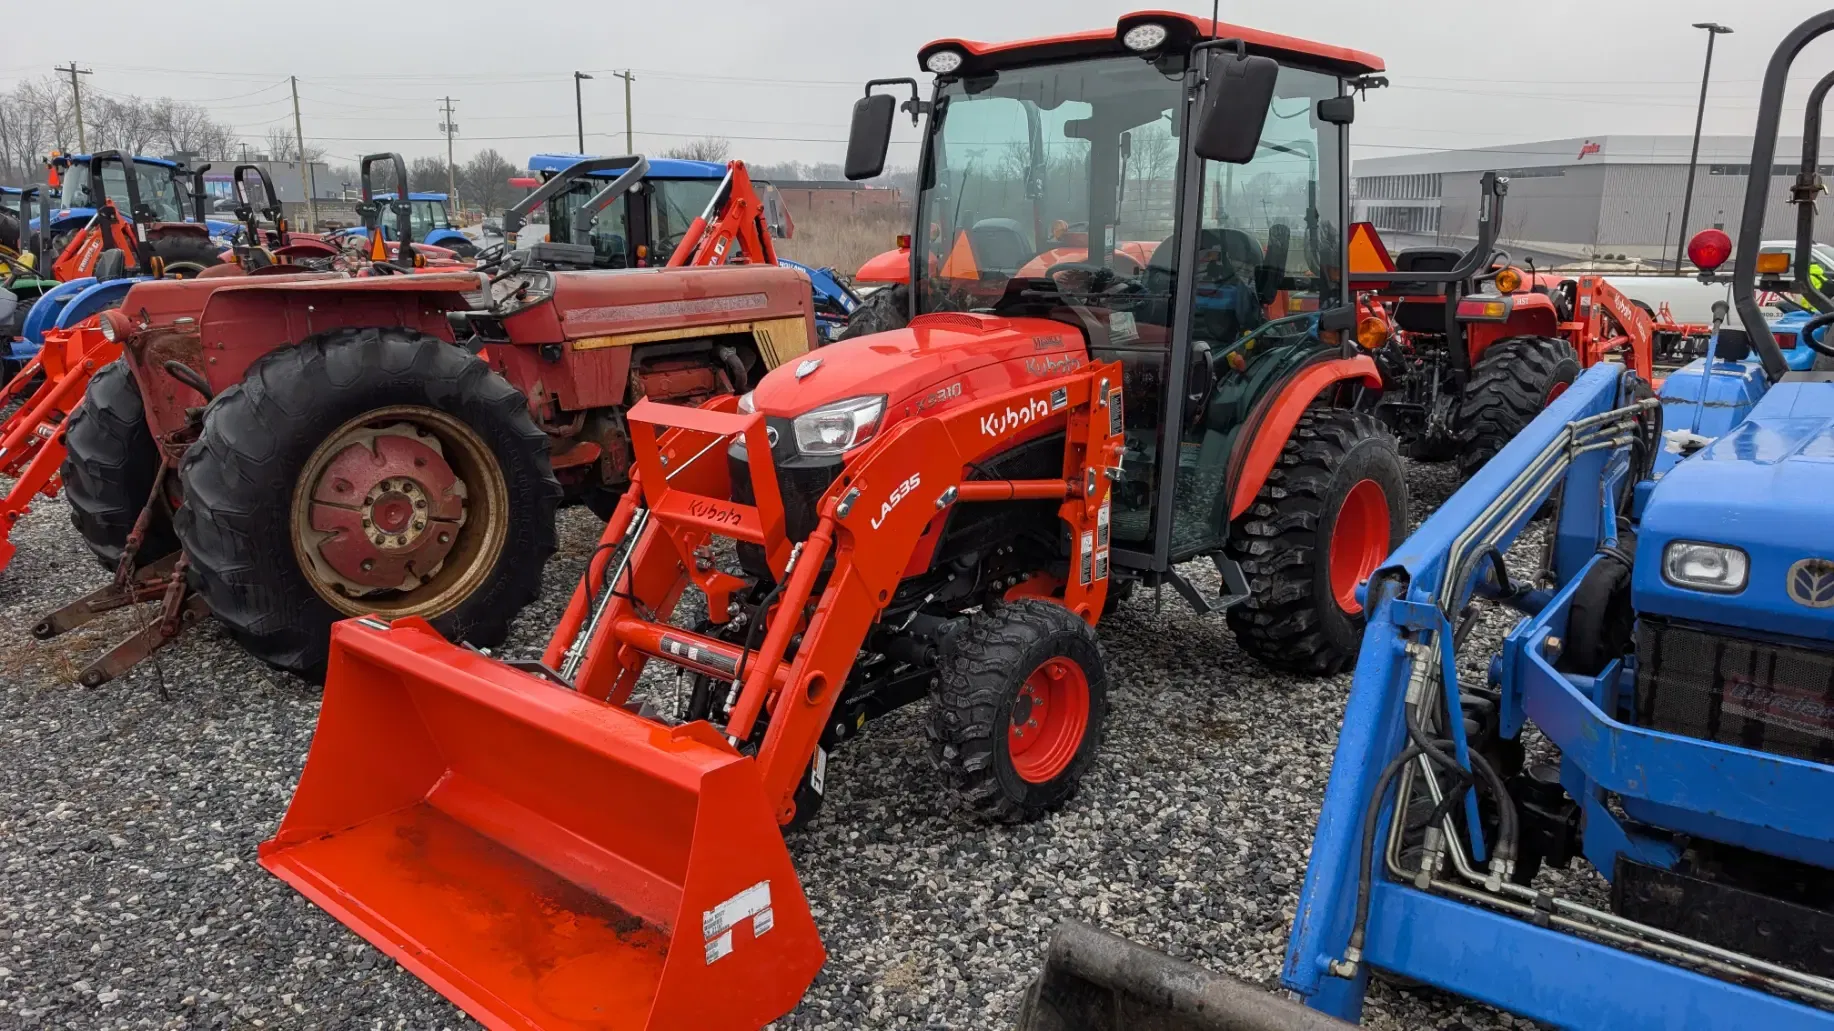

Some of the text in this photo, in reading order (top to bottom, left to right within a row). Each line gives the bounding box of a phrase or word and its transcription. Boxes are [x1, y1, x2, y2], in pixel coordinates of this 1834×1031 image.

[1025, 353, 1081, 377] Kubota
[980, 397, 1049, 437] Kubota
[688, 499, 742, 526] Kubota
[870, 471, 921, 530] LA535
